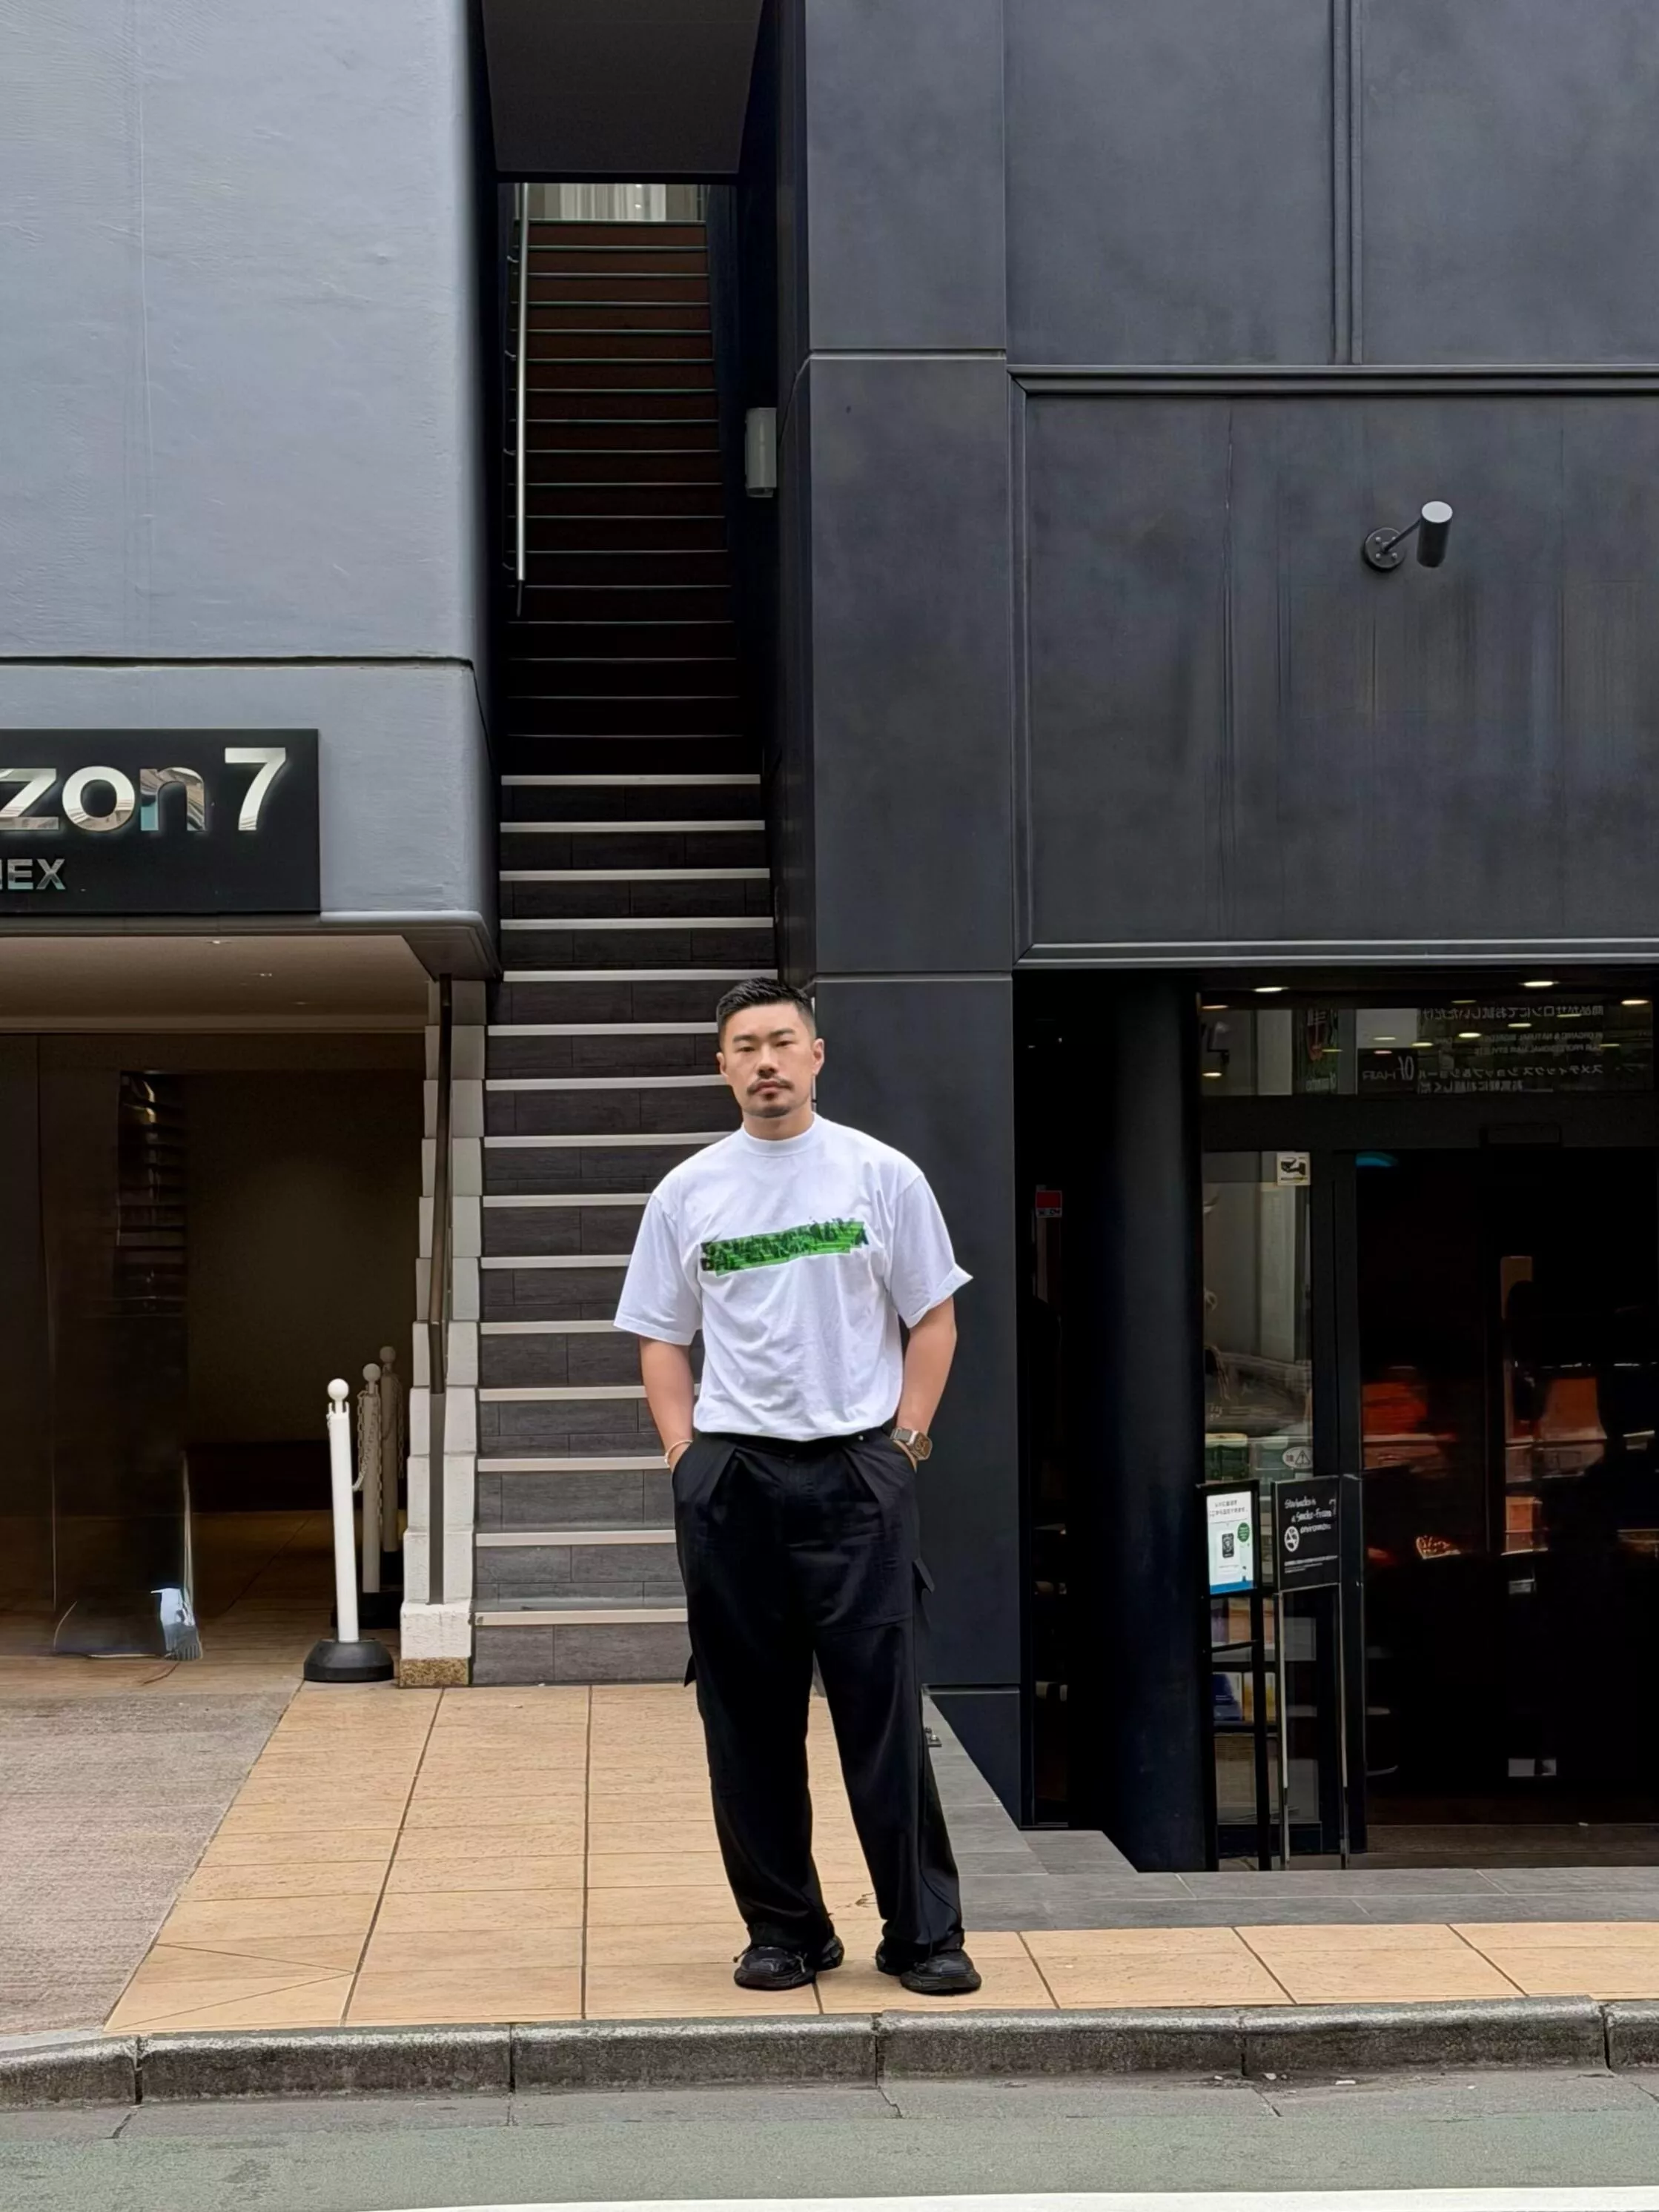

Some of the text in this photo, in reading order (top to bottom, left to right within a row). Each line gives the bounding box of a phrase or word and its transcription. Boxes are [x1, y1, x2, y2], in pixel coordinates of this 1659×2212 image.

[0, 747, 287, 832] zon 7
[0, 858, 65, 890] EX
